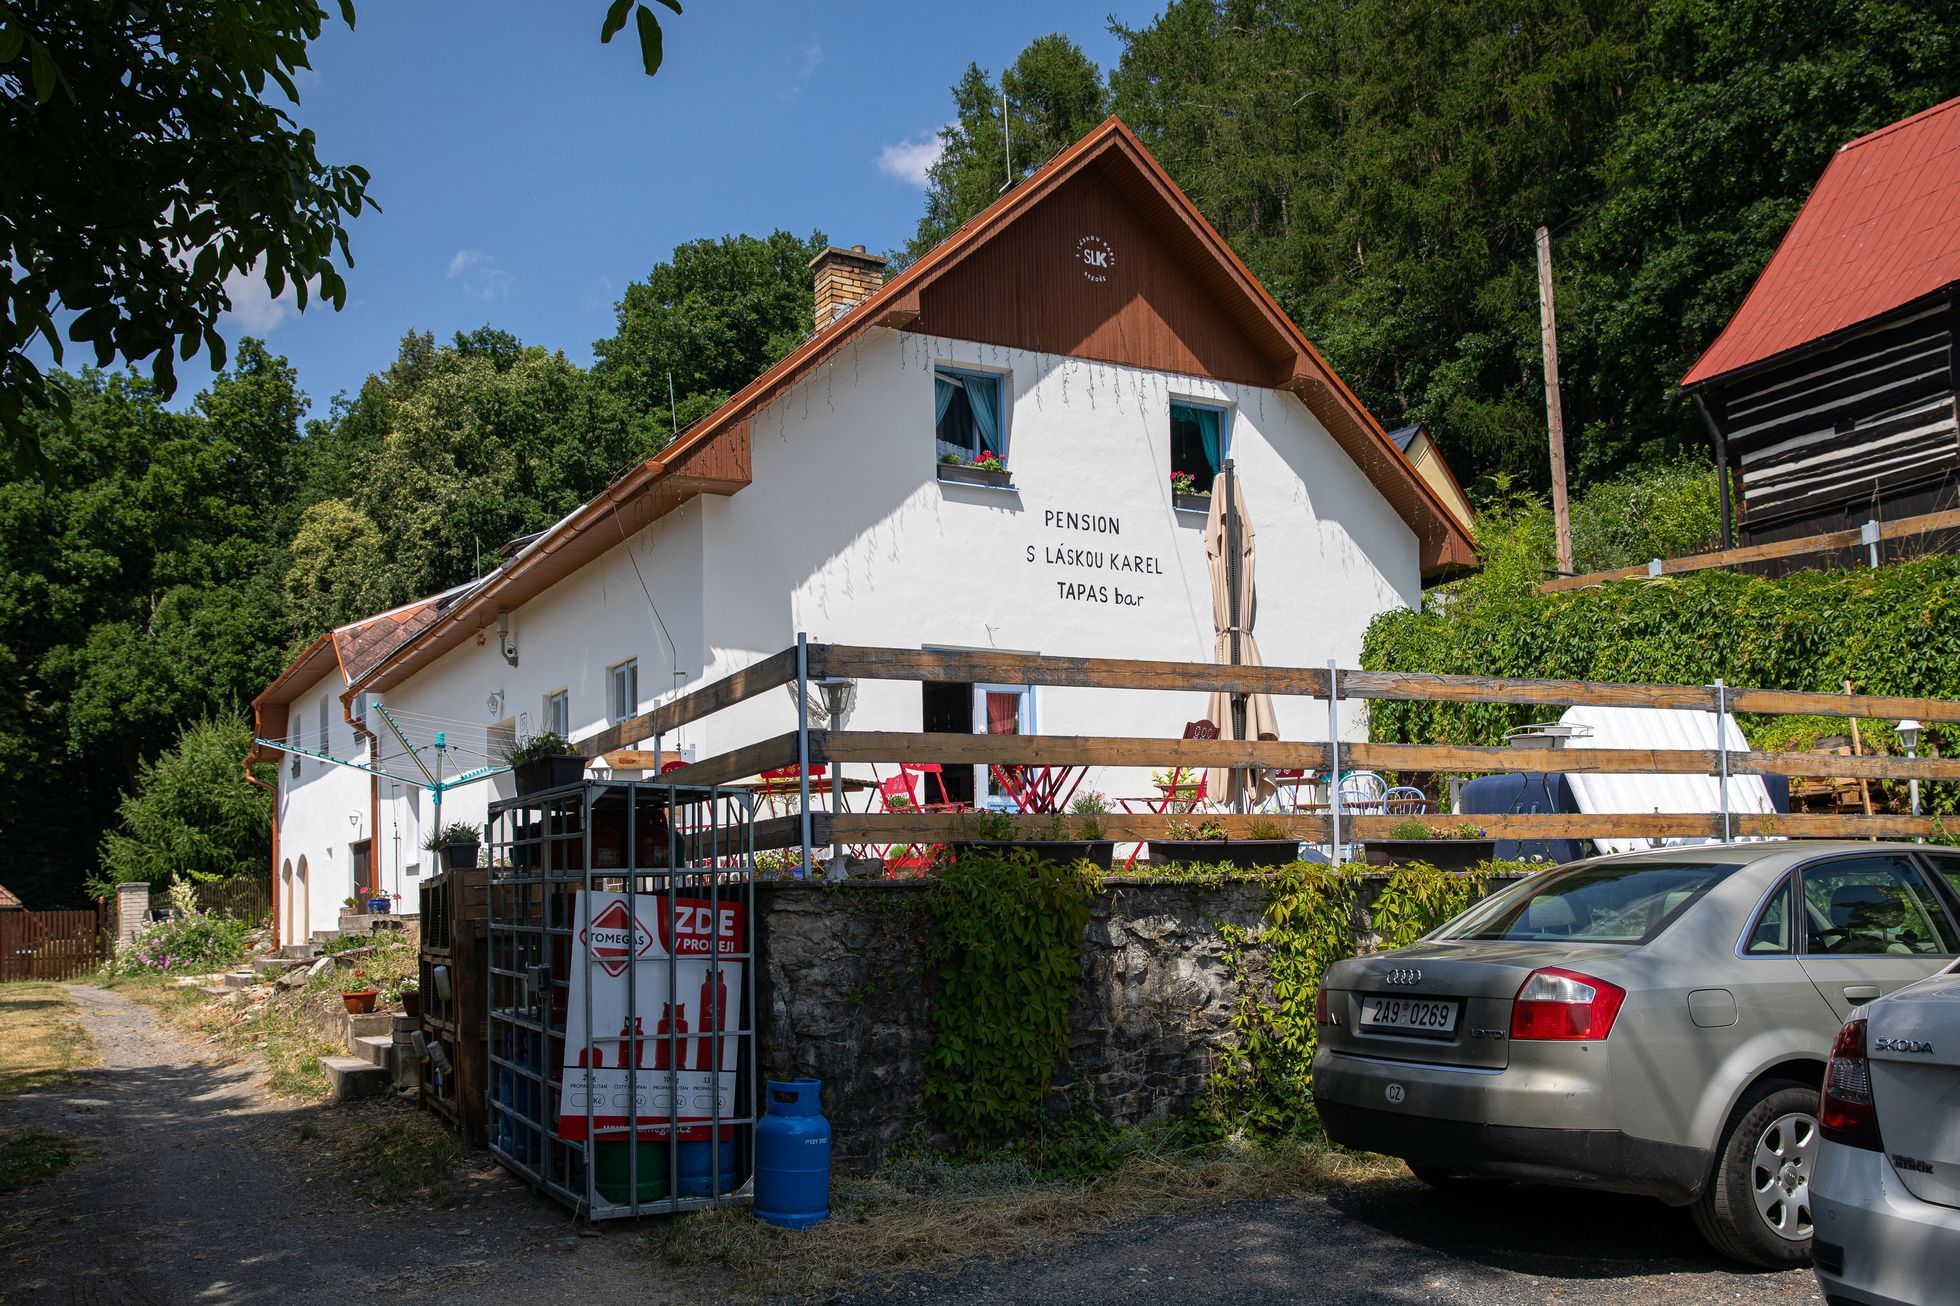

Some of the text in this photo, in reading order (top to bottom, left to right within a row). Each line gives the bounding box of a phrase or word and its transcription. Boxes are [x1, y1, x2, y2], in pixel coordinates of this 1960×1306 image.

[1083, 248, 1108, 268] SLK
[1045, 510, 1120, 535] PENSION
[1026, 543, 1163, 575] S LÁSKOU KAREL
[1057, 581, 1144, 607] TAPAS bar
[676, 905, 735, 937] ZDE
[1372, 1000, 1450, 1028] 2A9 0269
[1873, 1035, 1936, 1055] ŠKODA
[1388, 1086, 1402, 1101] CZ
